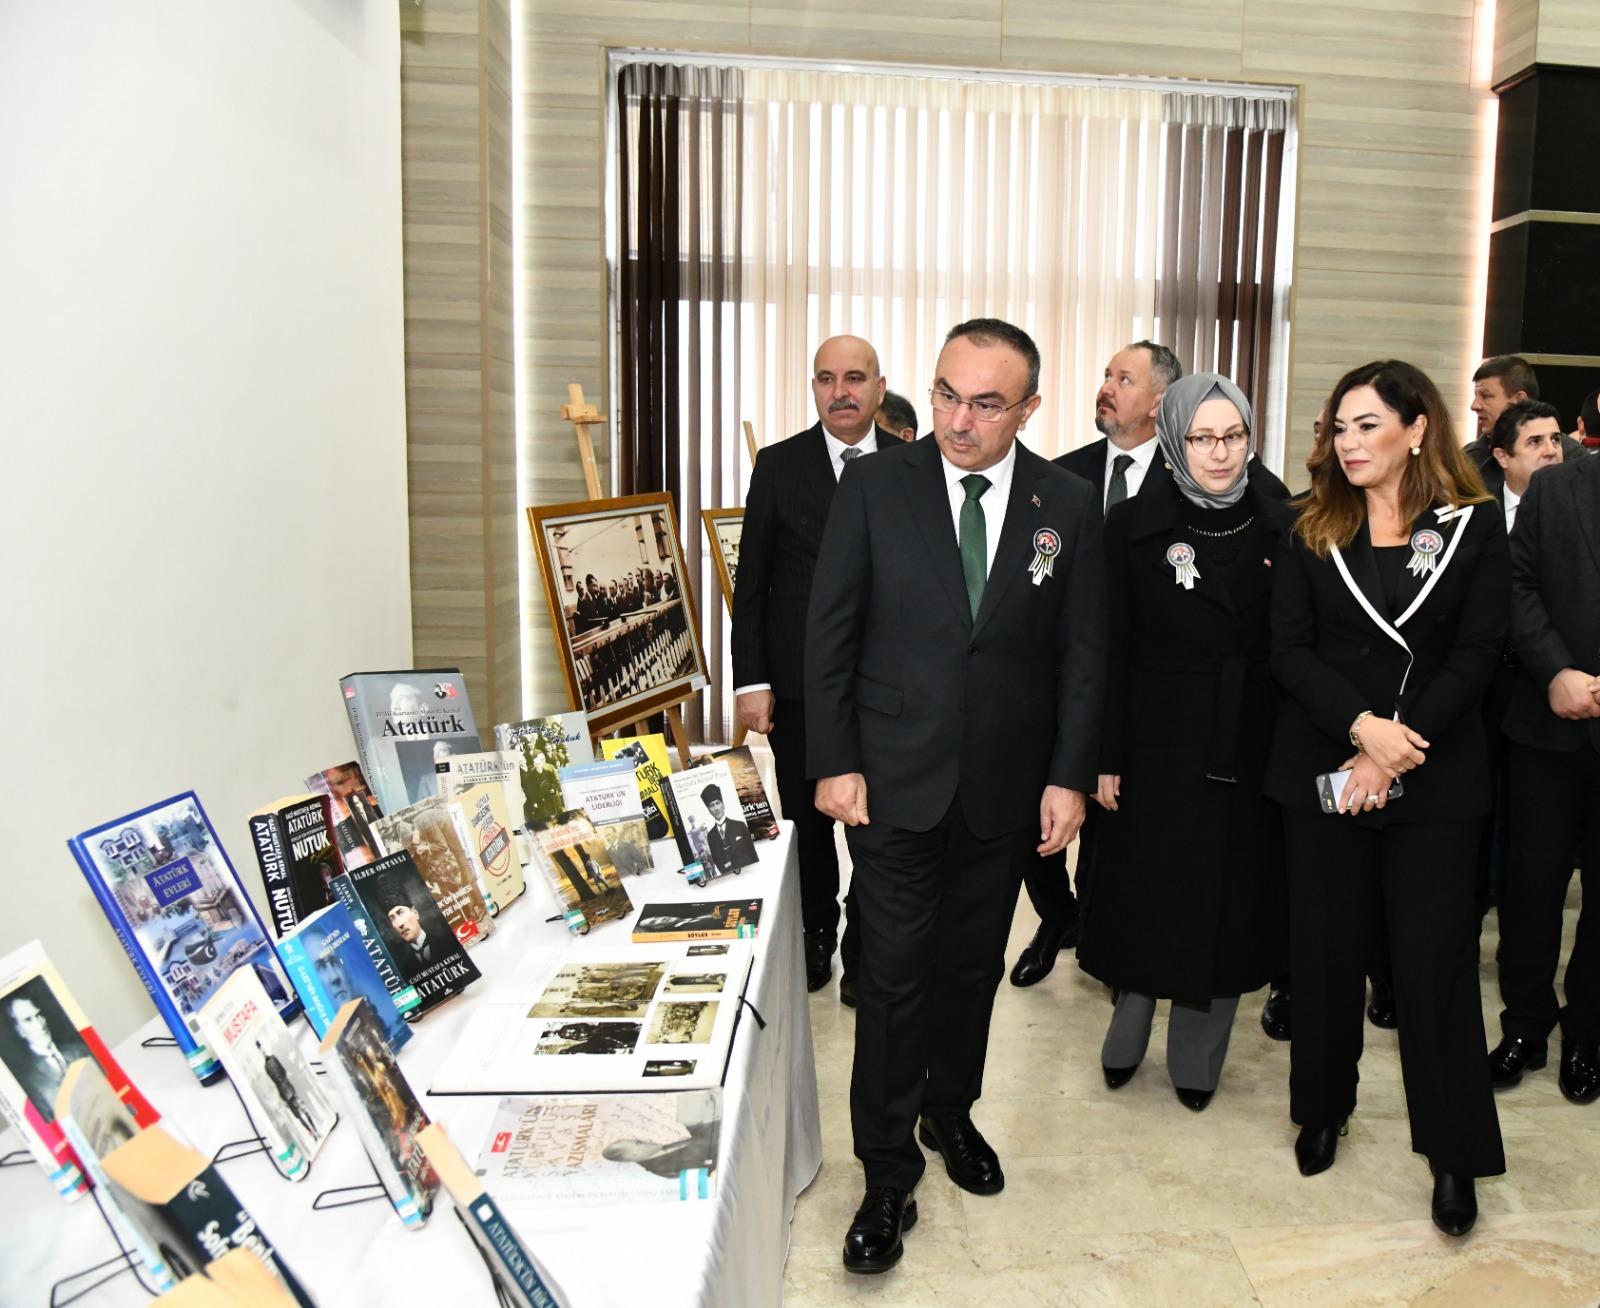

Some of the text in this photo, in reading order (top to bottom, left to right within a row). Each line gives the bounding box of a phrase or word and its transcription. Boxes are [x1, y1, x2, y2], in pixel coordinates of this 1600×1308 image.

[381, 714, 466, 738] Atatürk
[511, 723, 546, 737] Atatürk
[287, 808, 325, 835] ATATÜRK
[254, 821, 281, 883] ATATÜRK
[291, 829, 331, 862] NUTUK
[353, 855, 407, 881] İLBER ORTAYLI
[162, 876, 192, 899] EVLERİ
[421, 962, 445, 979] MUSTAFA
[443, 952, 462, 967] KEMAL
[135, 965, 156, 995] EVLERİ
[417, 960, 471, 999] ATATÜRK
[223, 1000, 257, 1045] MUSTAFA
